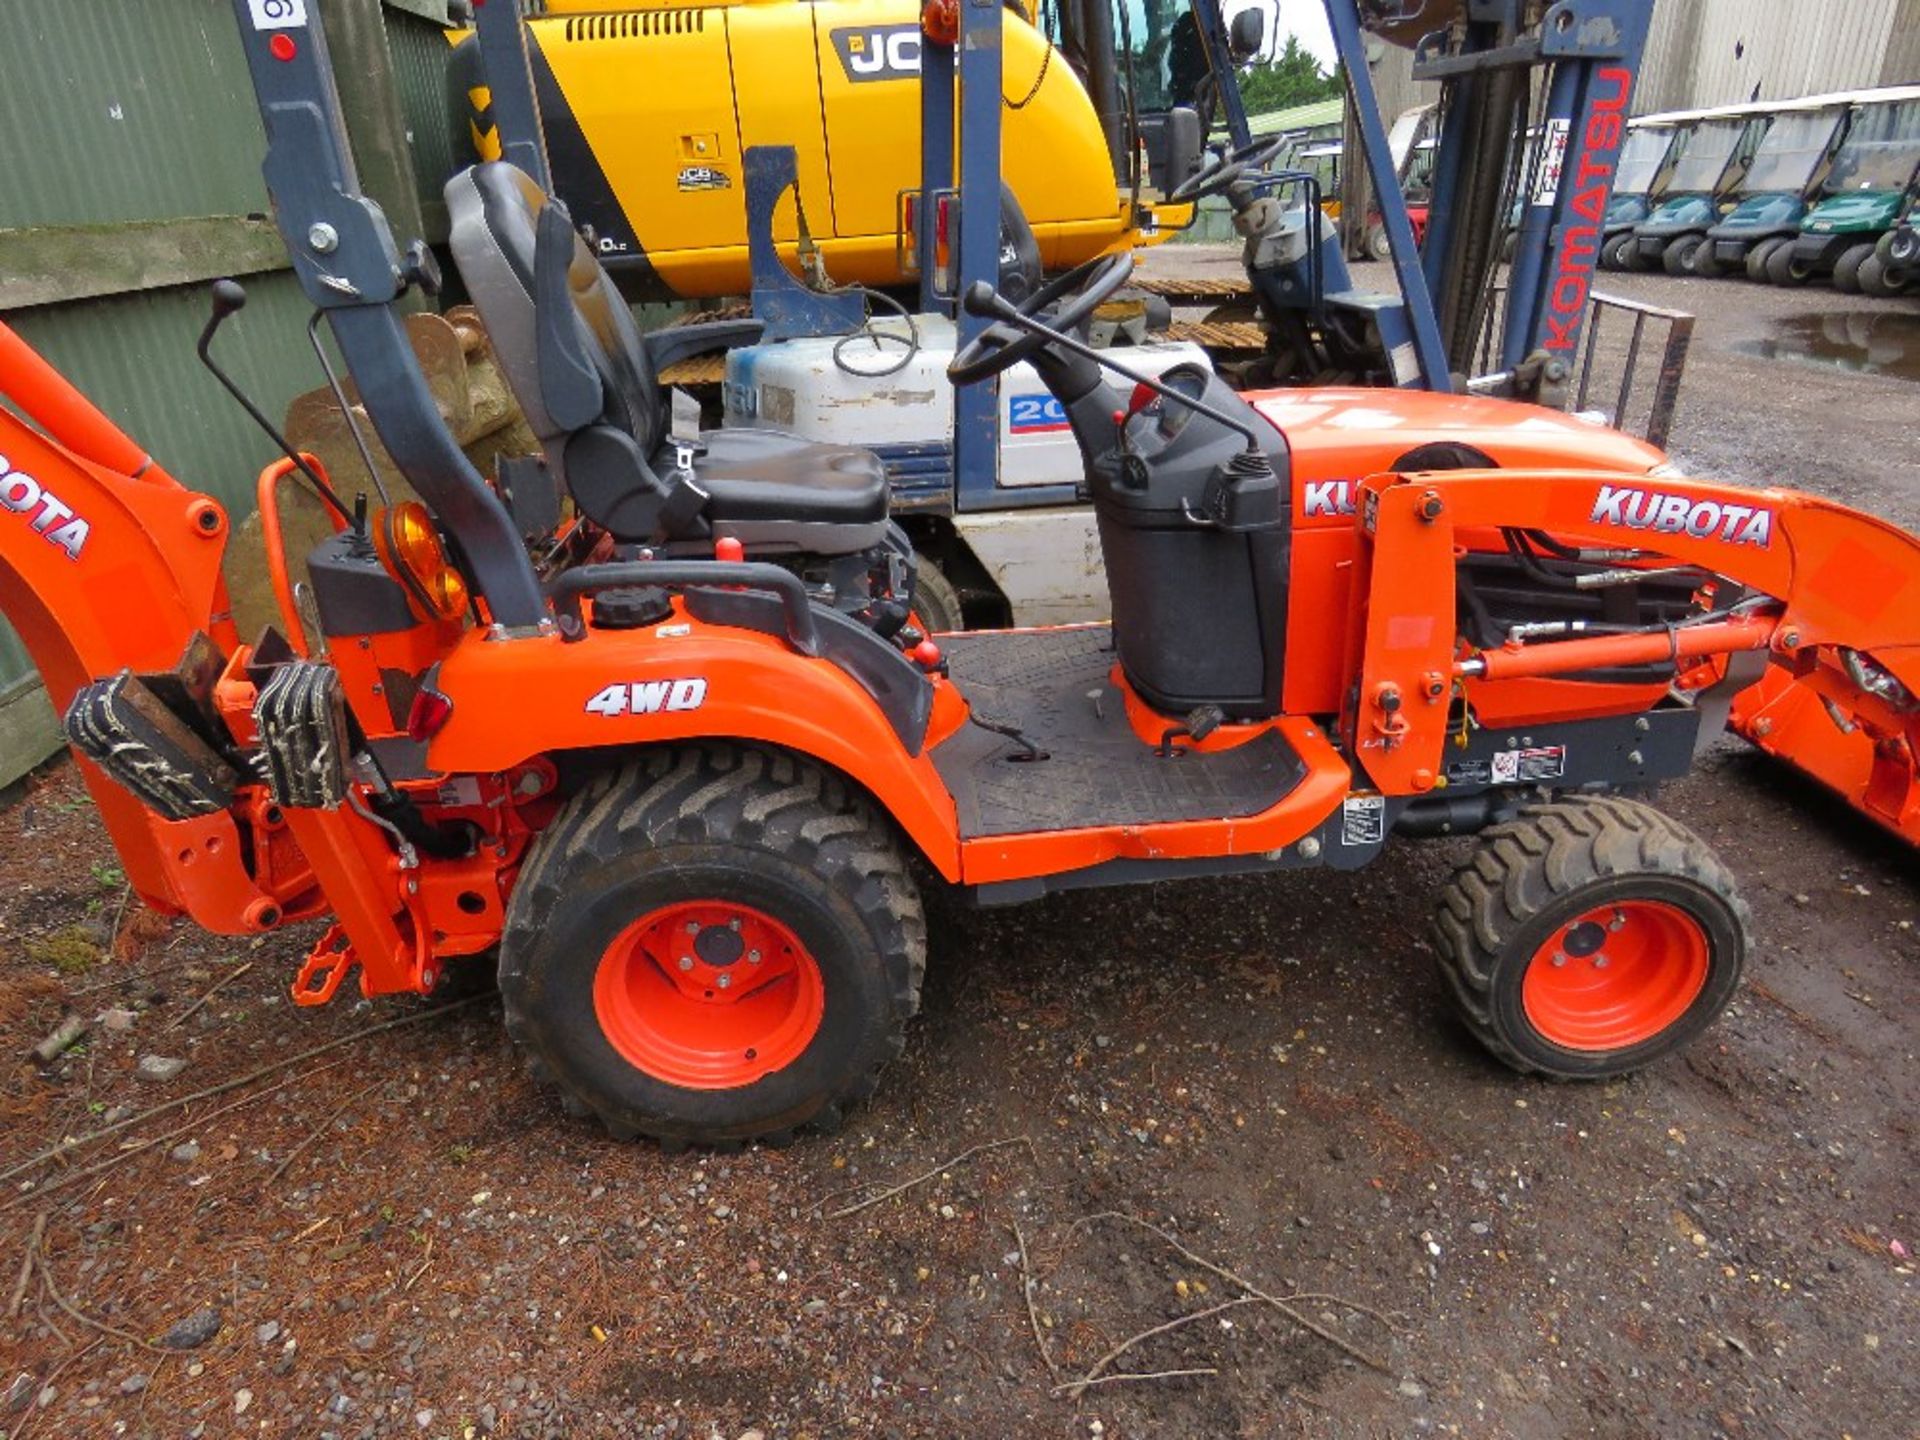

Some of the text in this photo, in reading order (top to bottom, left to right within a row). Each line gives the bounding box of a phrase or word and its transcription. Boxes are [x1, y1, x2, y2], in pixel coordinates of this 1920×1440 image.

[1543, 67, 1632, 350] KOMATSU
[0, 452, 91, 562] OTA
[1590, 484, 1771, 549] KUBOTA
[584, 677, 709, 717] 4WD
